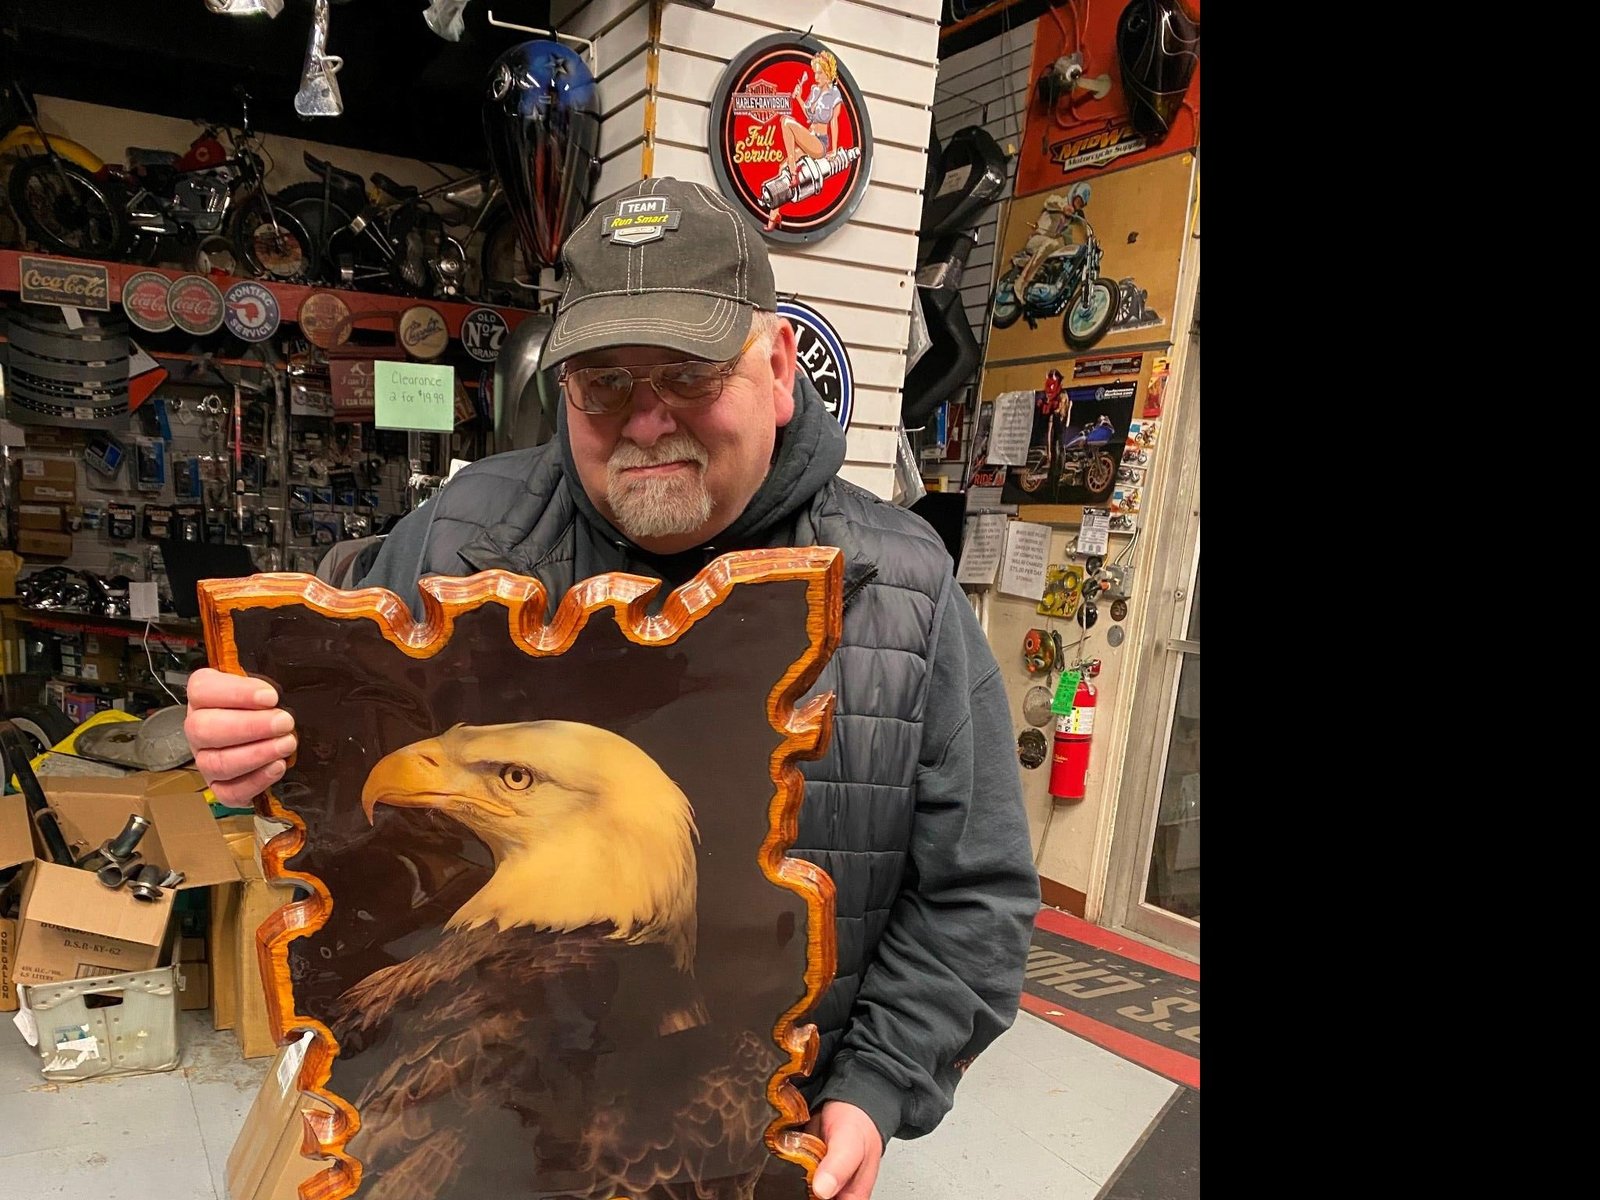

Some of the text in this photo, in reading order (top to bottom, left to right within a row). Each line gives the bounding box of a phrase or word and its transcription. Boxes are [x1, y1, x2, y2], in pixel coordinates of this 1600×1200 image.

[735, 97, 790, 108] HARLEY-DAVIDSON
[745, 125, 777, 147] Full
[1060, 127, 1134, 160] MIDW
[733, 141, 785, 163] Service
[1067, 148, 1114, 167] Motorcycle
[627, 202, 656, 213] TEAM
[610, 214, 669, 228] Run Smart
[229, 286, 273, 307] PONTIAC
[477, 313, 497, 323] OLD
[230, 319, 273, 338] SERVICE
[471, 348, 499, 358] BRAND
[391, 370, 443, 387] Clearance
[401, 390, 415, 403] for
[974, 473, 993, 485] RIDE
[1, 956, 9, 999] GALLON
